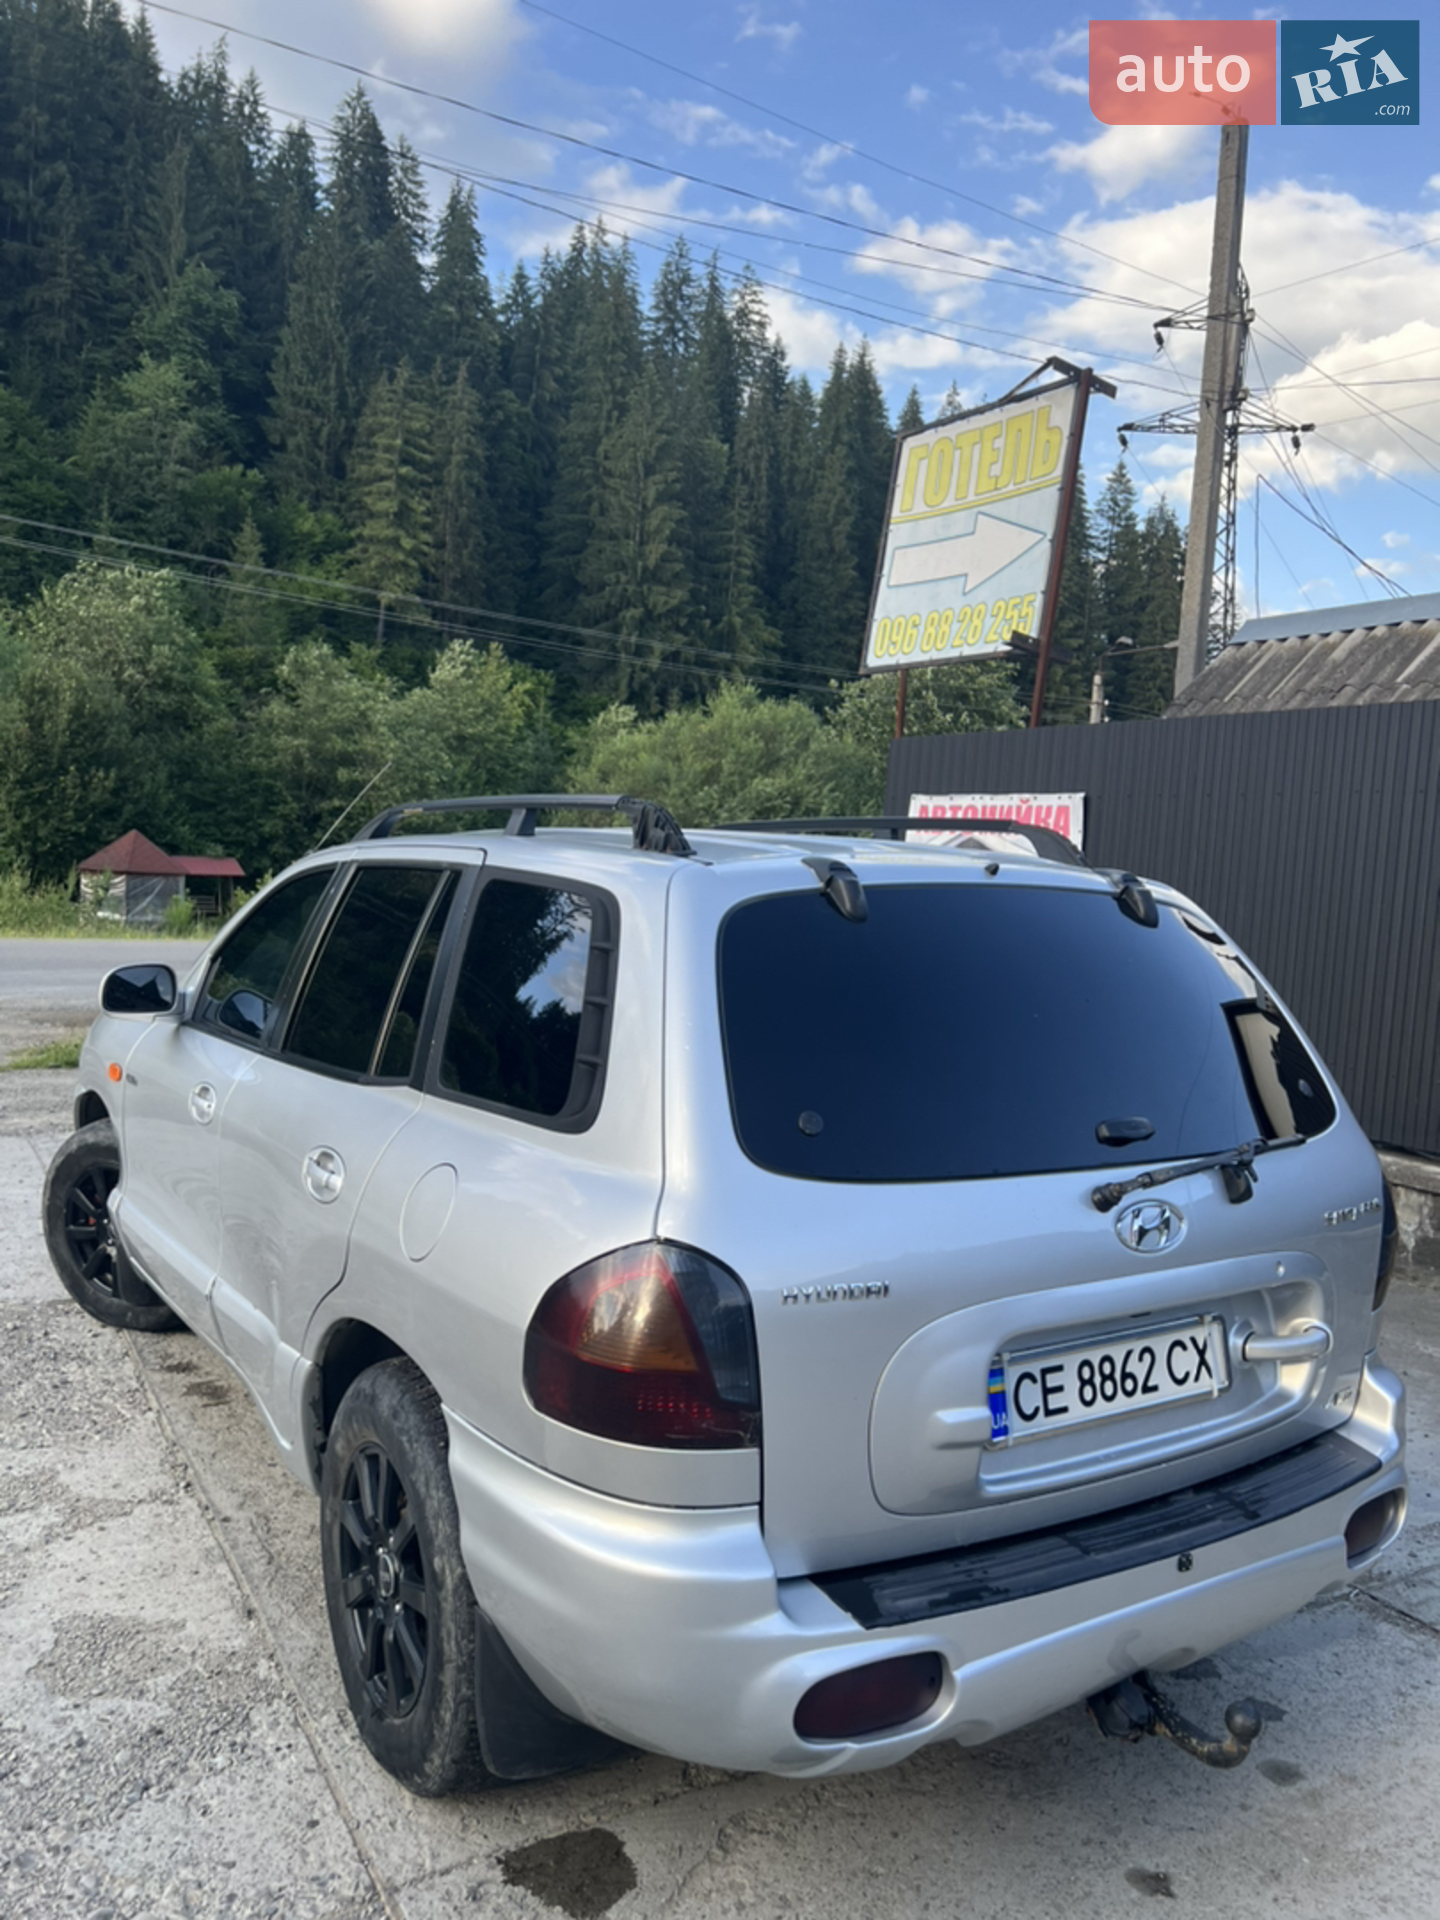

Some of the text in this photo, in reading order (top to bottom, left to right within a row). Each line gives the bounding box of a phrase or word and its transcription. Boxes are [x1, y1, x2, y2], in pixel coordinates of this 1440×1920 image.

[899, 404, 1063, 514] ГОТЕЛЬ
[874, 592, 1037, 659] 096 88 28 255
[781, 1280, 890, 1306] HYUNDAI
[1013, 1335, 1214, 1423] CE 8862 CX
